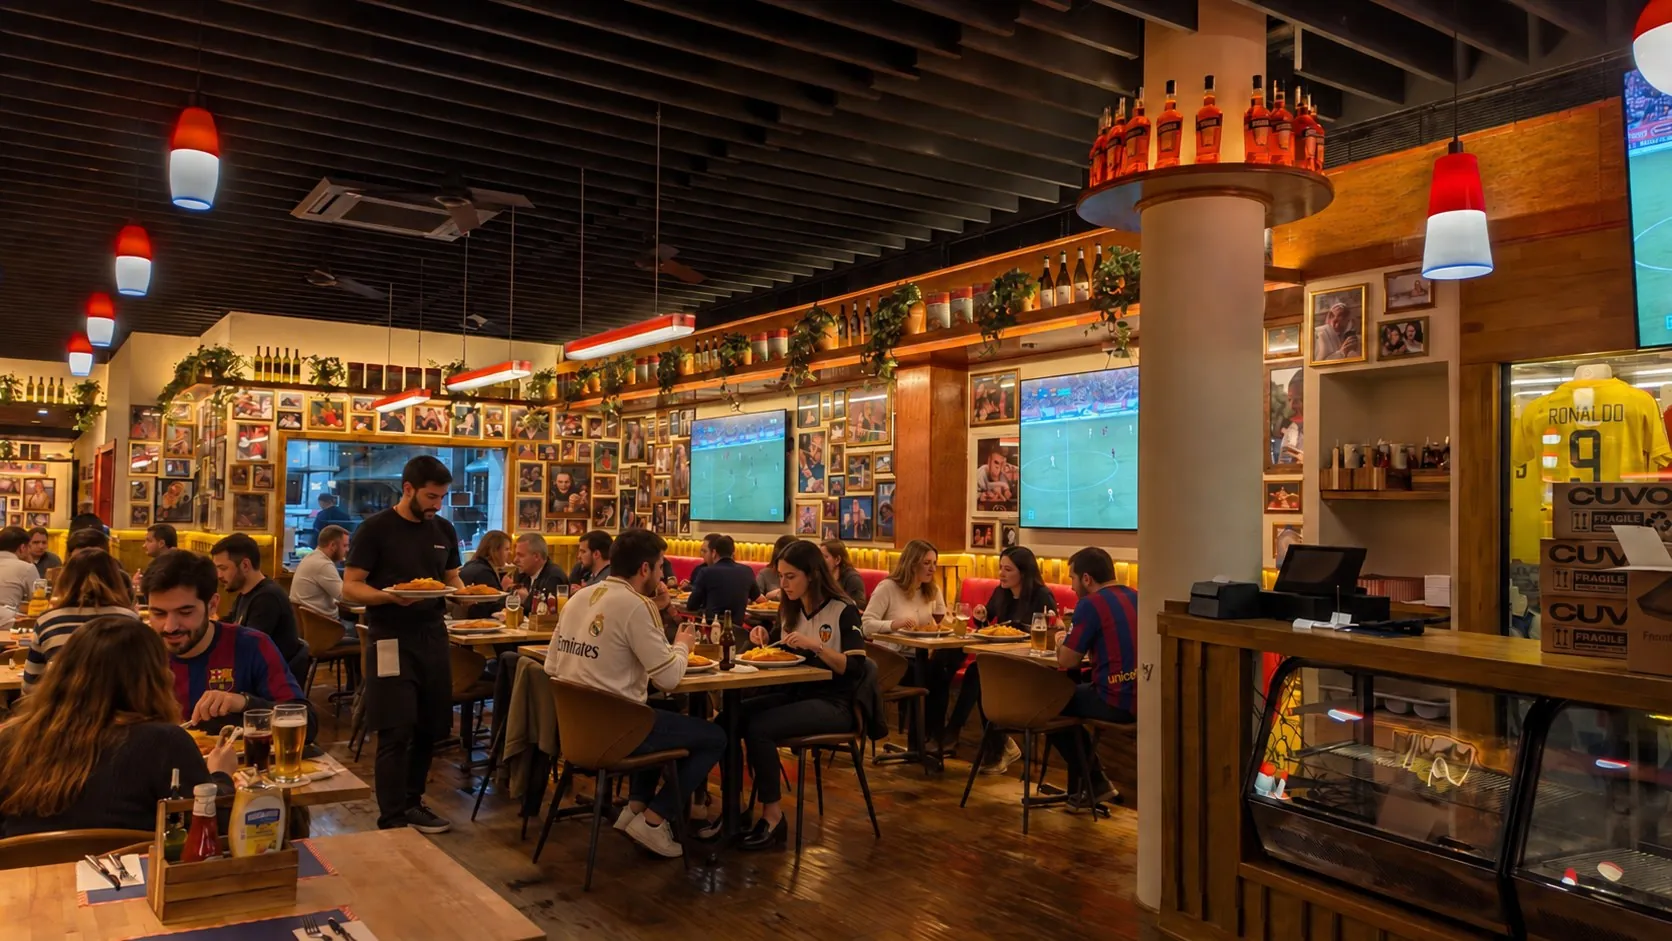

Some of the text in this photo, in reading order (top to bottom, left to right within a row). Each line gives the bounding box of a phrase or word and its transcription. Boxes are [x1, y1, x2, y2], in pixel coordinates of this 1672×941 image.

[1549, 404, 1624, 424] RONALDO
[1570, 429, 1601, 483] 9
[1593, 514, 1641, 523] FRAGILE
[1575, 573, 1625, 584] FRAGILE
[1575, 632, 1625, 644] FRAGILE
[1108, 669, 1137, 684] unice
